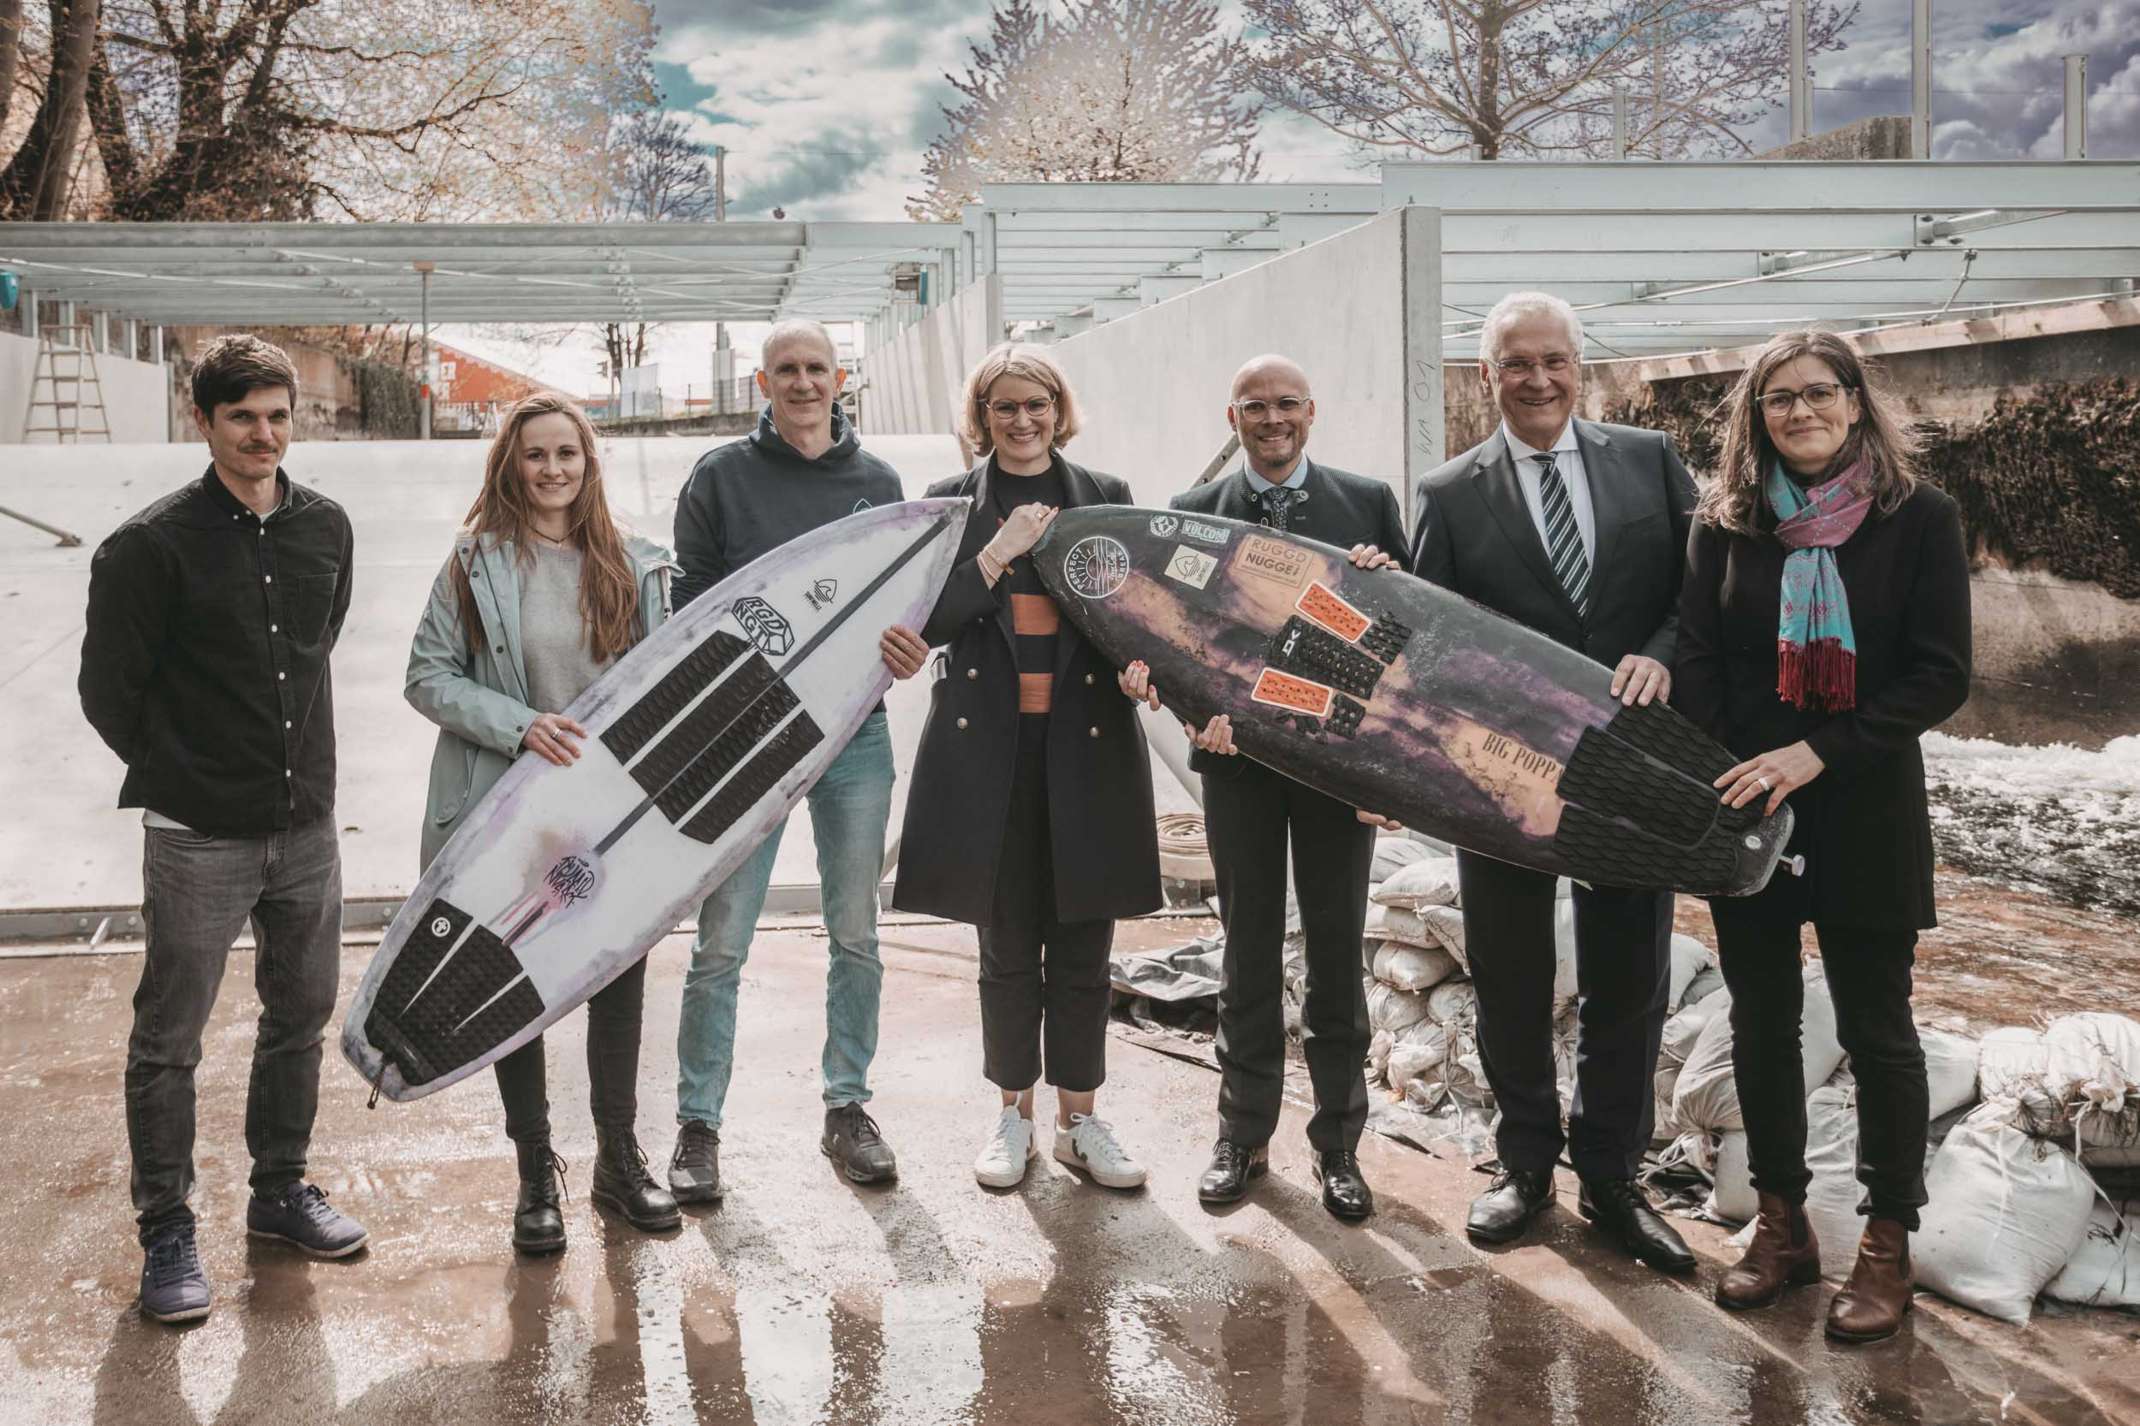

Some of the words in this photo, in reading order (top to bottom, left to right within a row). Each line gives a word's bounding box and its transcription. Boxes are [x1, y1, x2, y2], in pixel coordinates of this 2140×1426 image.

[1068, 546, 1086, 591] PERFECT
[735, 603, 768, 643] NGT
[746, 600, 785, 630] RGD
[1482, 732, 1512, 759] BIG
